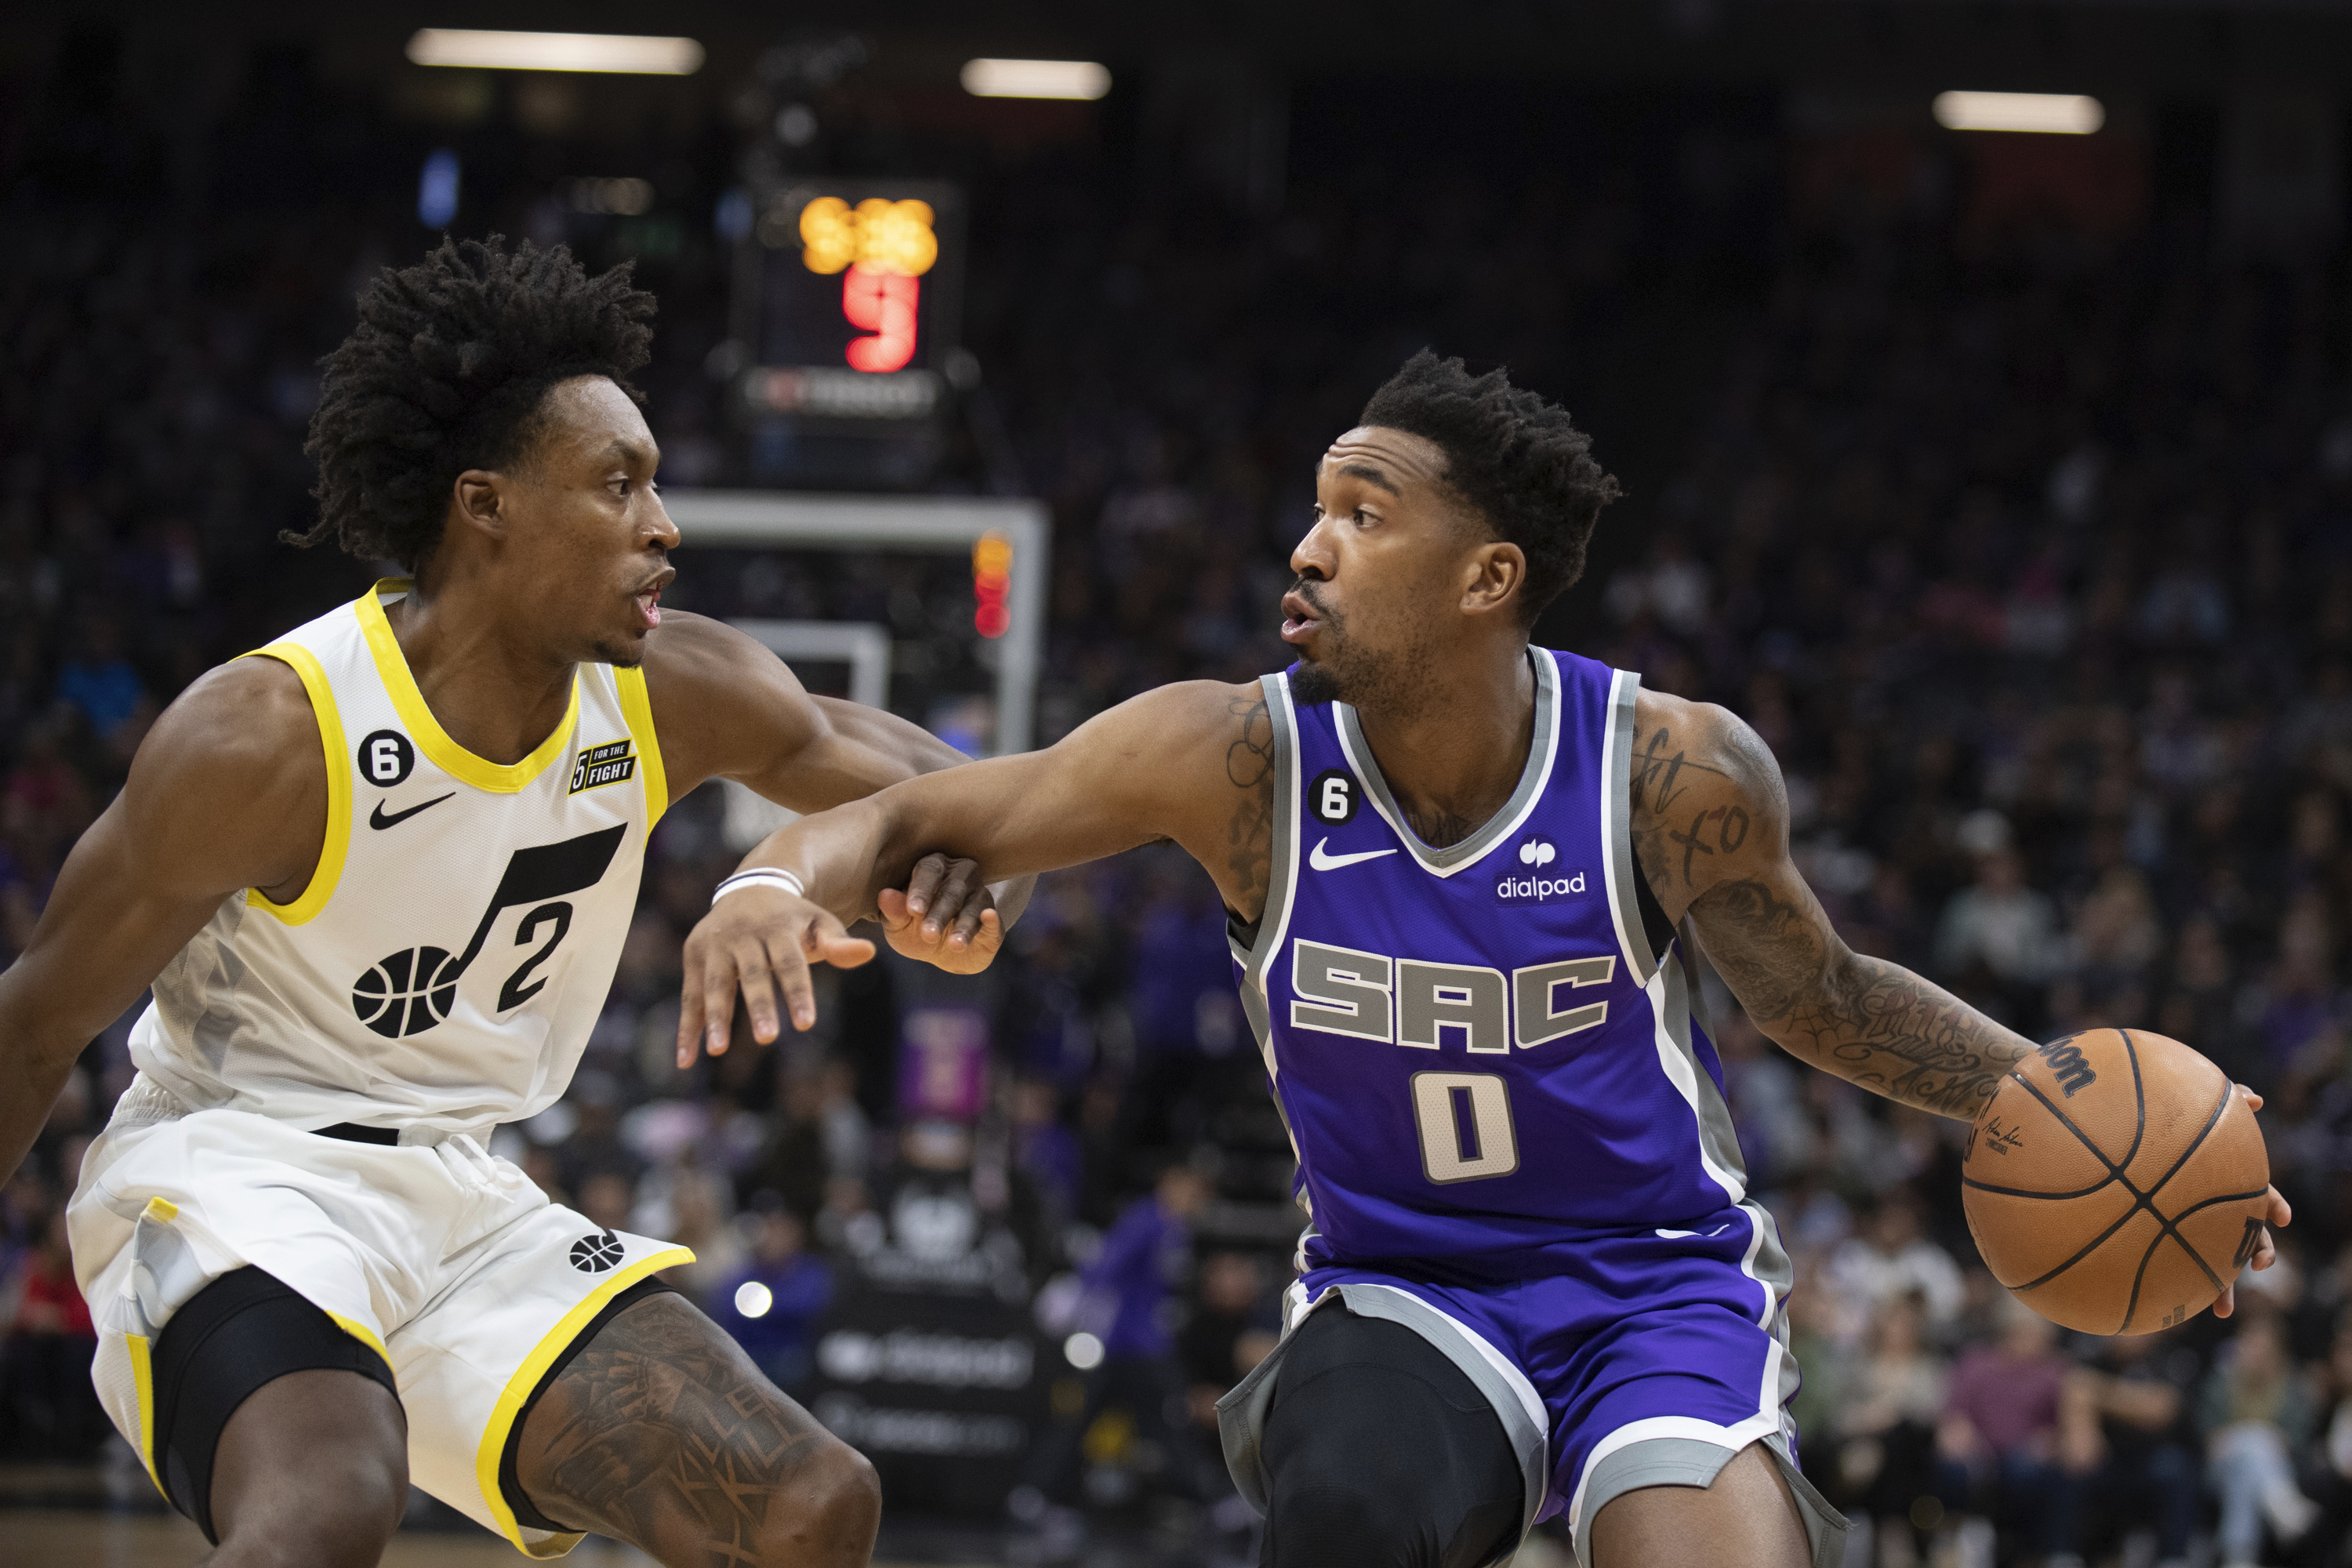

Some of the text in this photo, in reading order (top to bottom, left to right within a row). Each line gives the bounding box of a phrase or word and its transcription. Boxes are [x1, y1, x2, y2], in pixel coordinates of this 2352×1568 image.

[371, 739, 400, 779] 6
[572, 754, 587, 789] 5
[589, 761, 630, 784] FIGHT
[593, 745, 626, 760] FOR THE
[1321, 778, 1348, 819] 6
[1497, 872, 1585, 901] dialpad
[496, 901, 573, 1013] 2
[1290, 938, 1617, 1054] SAC
[1409, 1069, 1520, 1185] 0
